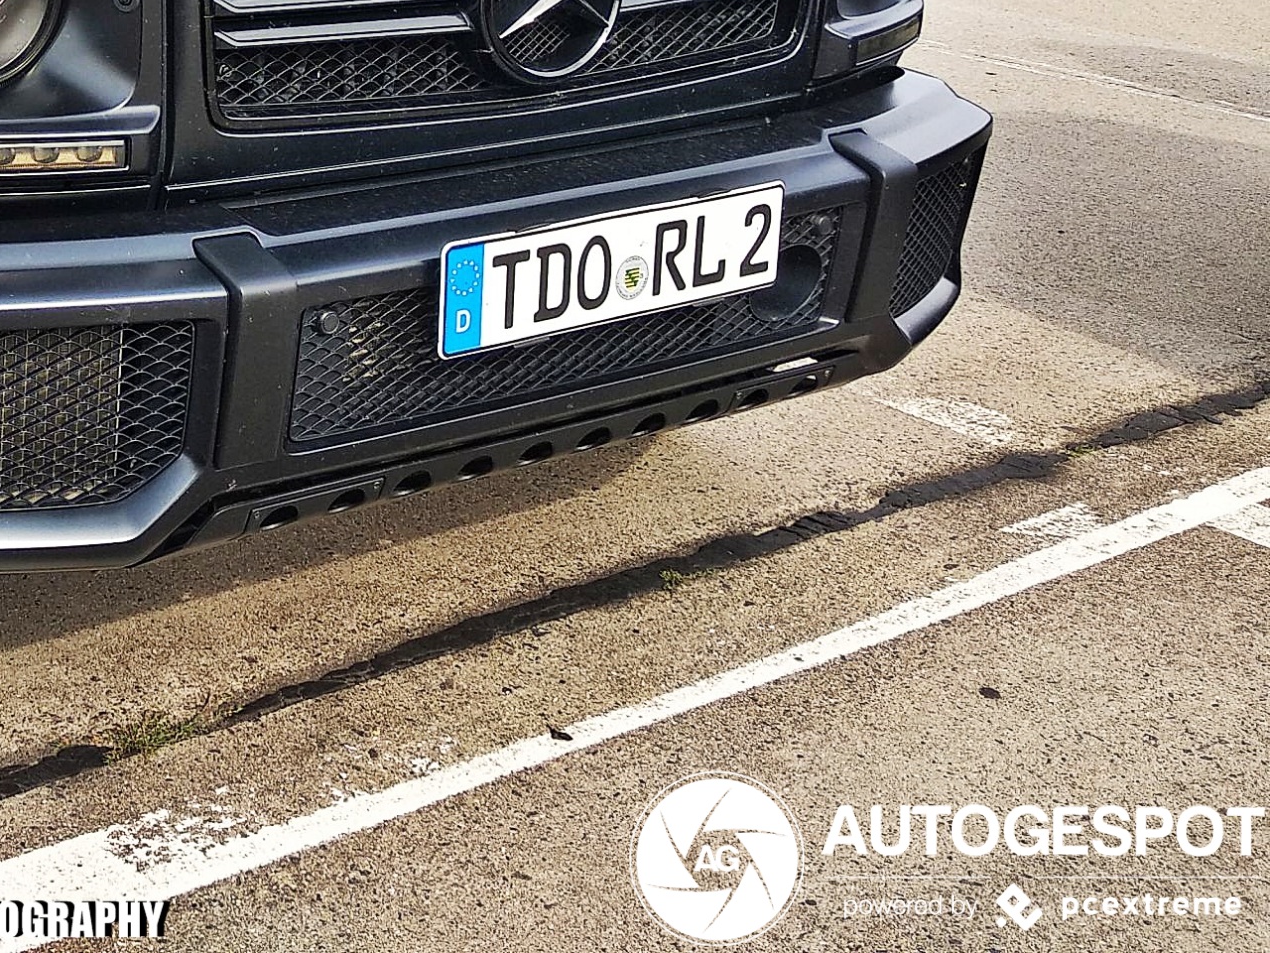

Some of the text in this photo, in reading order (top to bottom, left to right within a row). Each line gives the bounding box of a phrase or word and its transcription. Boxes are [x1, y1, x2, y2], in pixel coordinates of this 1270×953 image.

[492, 234, 612, 330] TDO
[652, 215, 726, 297] RL
[739, 203, 772, 278] 2
[455, 309, 471, 334] D
